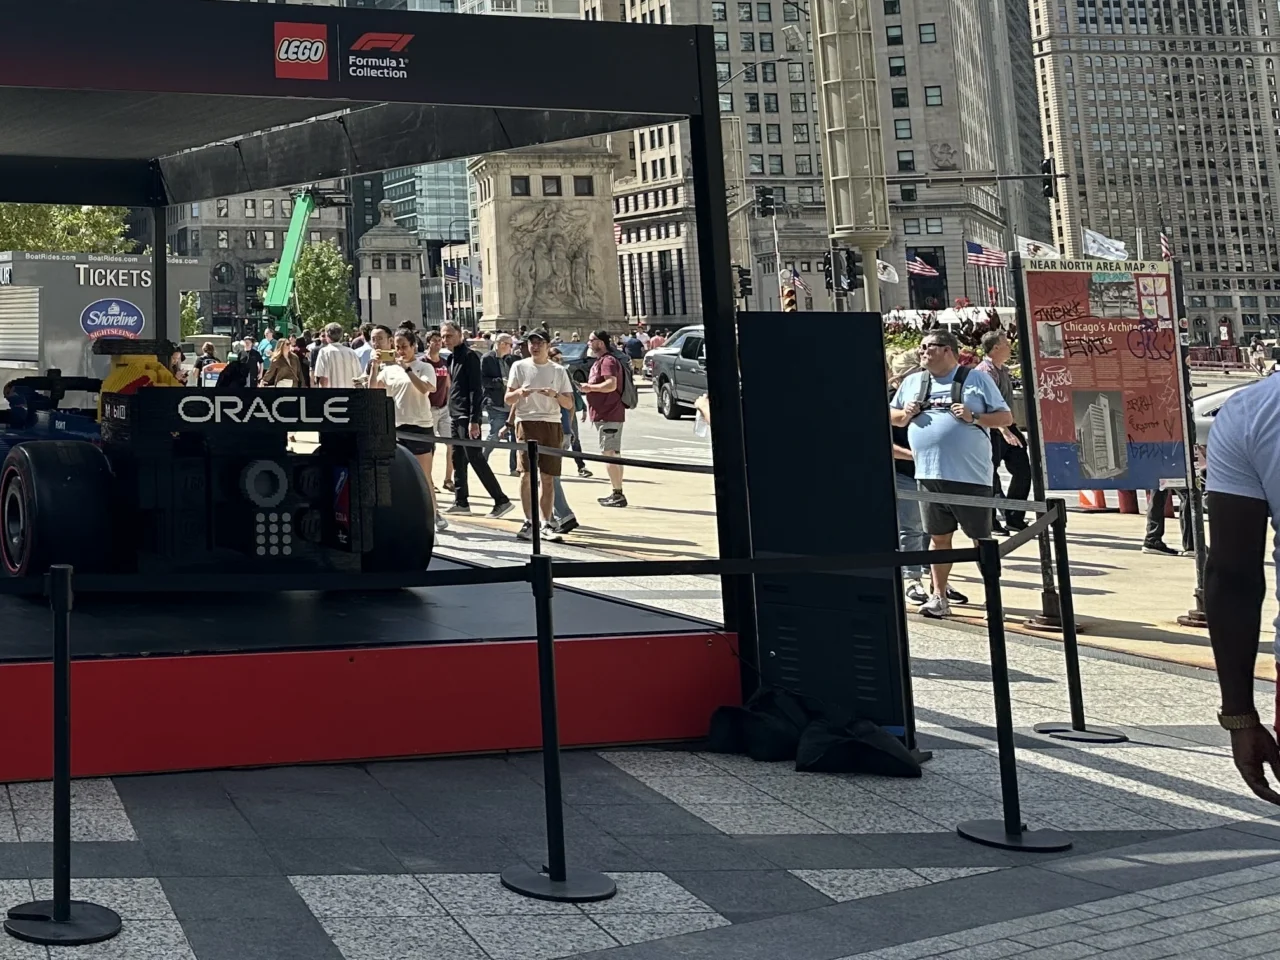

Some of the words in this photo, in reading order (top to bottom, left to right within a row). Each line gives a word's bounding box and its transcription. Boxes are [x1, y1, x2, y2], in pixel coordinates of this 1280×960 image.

[277, 38, 326, 63] LEGO
[349, 56, 397, 67] Formula
[349, 67, 407, 78] Collection
[25, 252, 76, 260] BoatRides.com
[88, 254, 138, 262] BoatRides.com
[1030, 260, 1056, 270] NEAR
[1060, 261, 1093, 270] NORTH
[1096, 262, 1121, 271] AREA
[1124, 263, 1146, 271] MAP
[74, 263, 152, 287] TICKETS
[87, 310, 138, 326] Shoreline
[1064, 321, 1106, 334] Chicago's
[90, 328, 135, 339] SIGHTSEEING
[178, 395, 350, 423] ORACLE
